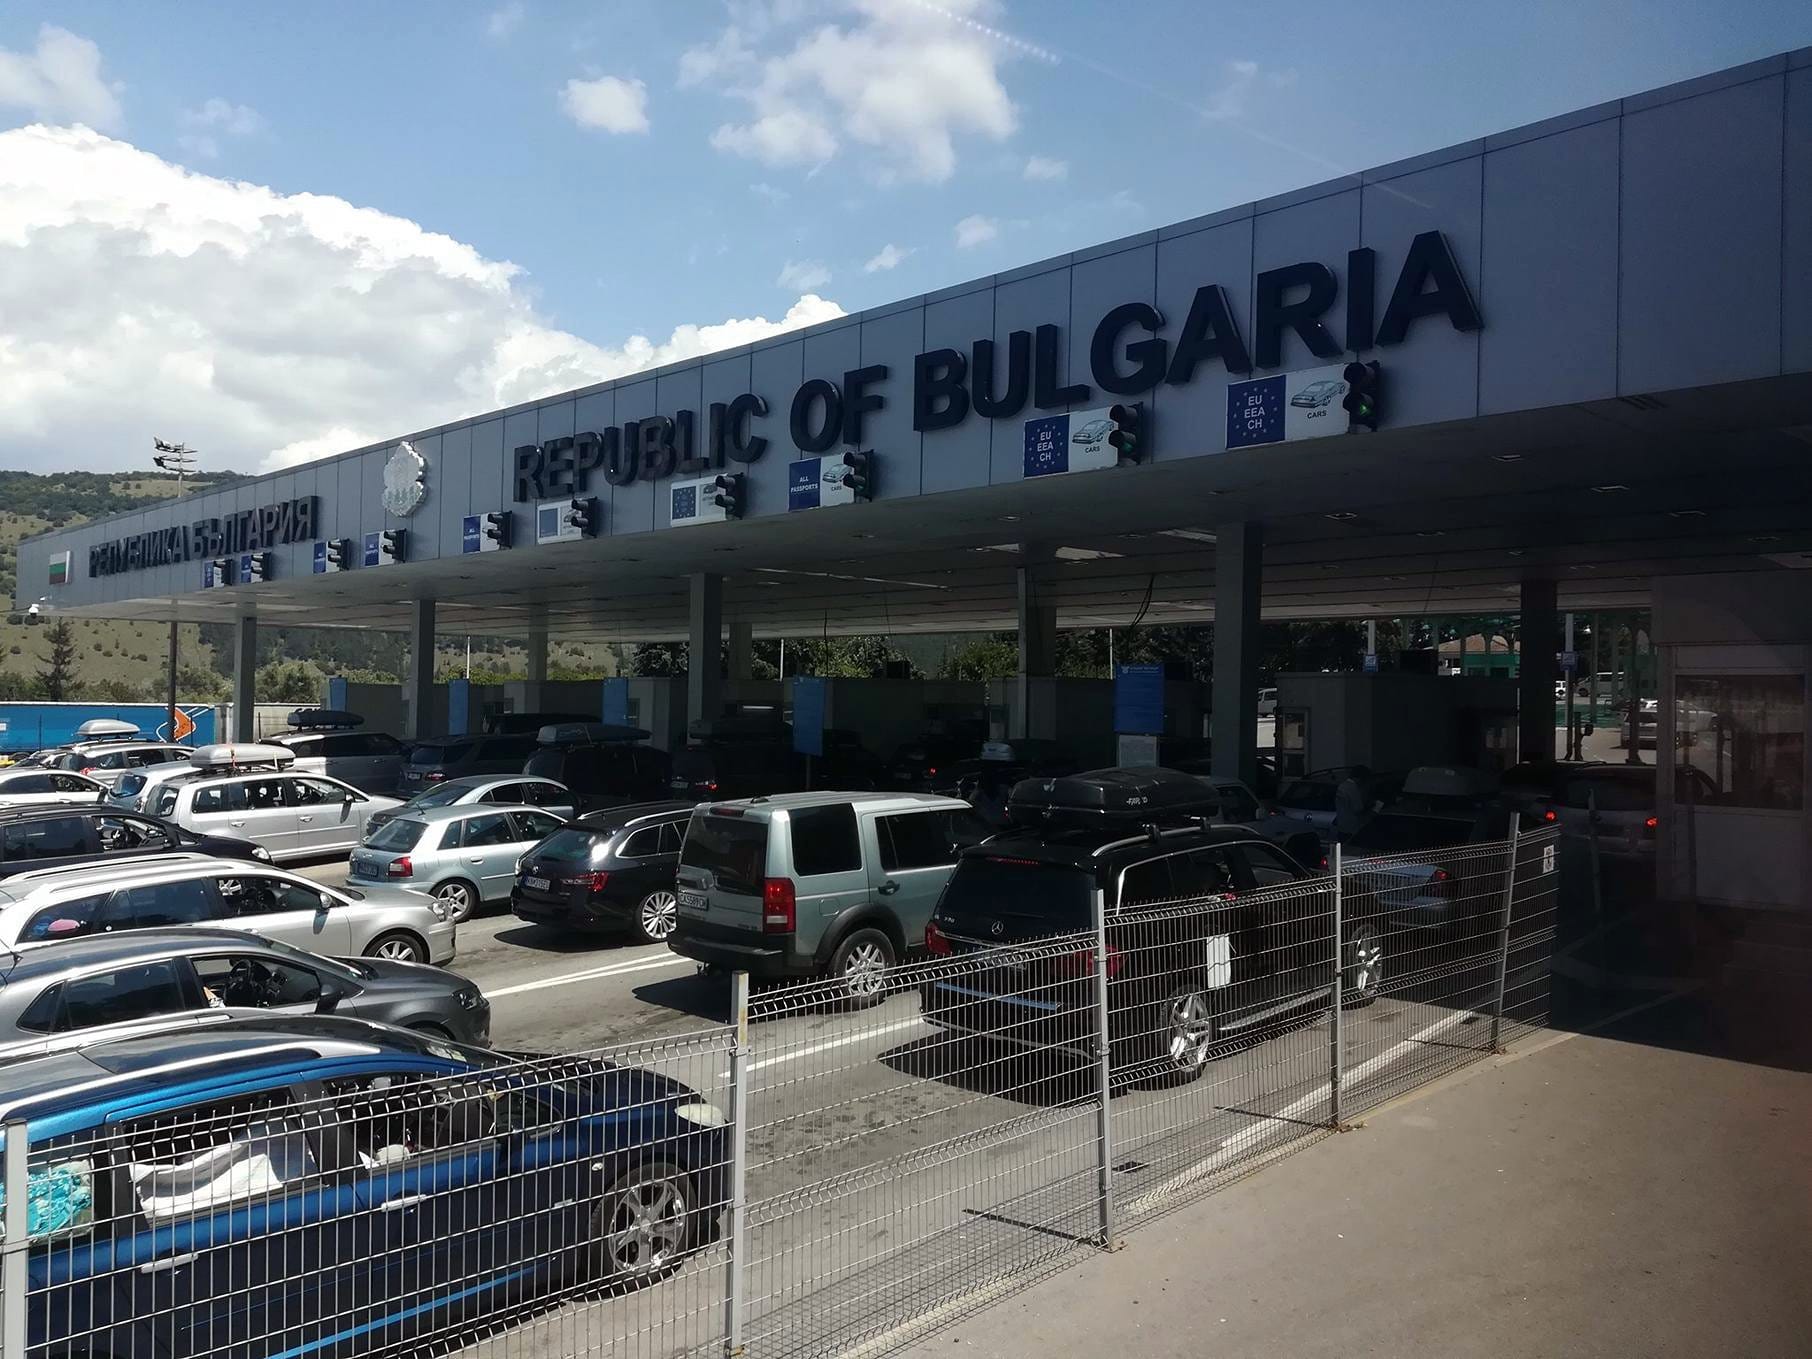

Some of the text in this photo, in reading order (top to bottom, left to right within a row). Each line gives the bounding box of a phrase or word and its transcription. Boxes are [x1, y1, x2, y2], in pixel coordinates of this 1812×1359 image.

[513, 230, 1484, 502] REPUBLIC OF BULGARIA
[1248, 395, 1263, 406] EU
[1244, 406, 1266, 419] EEA
[1307, 410, 1327, 419] CARS
[1247, 419, 1263, 430] CH
[1040, 431, 1052, 441] EU
[1037, 442, 1054, 452] EEA
[1085, 445, 1100, 453] CARS
[1039, 452, 1052, 462] CH
[790, 483, 819, 493] PASSPORTS
[88, 495, 320, 578] РЕПУБЛИКА БЪЛГАРИЯ
